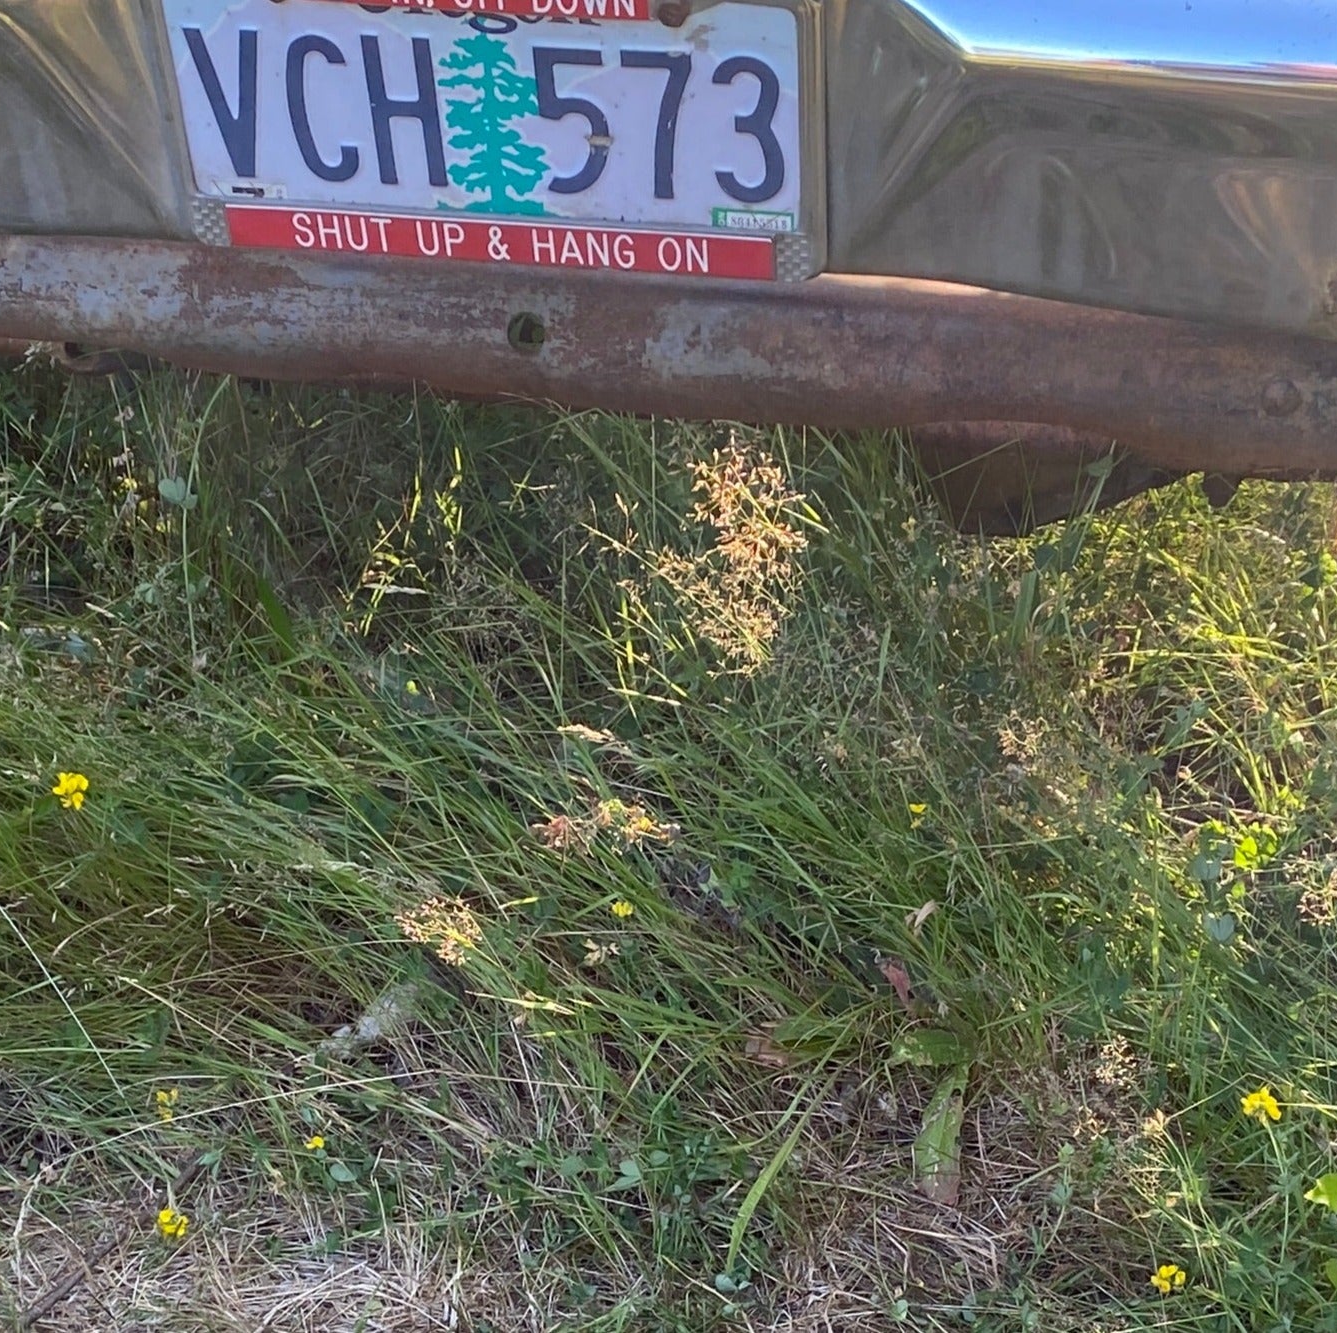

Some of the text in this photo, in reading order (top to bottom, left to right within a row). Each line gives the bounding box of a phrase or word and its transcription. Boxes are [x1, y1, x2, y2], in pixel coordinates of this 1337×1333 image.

[182, 27, 786, 203] VCH 573
[292, 212, 709, 273] SHUT UP & HANG ON
